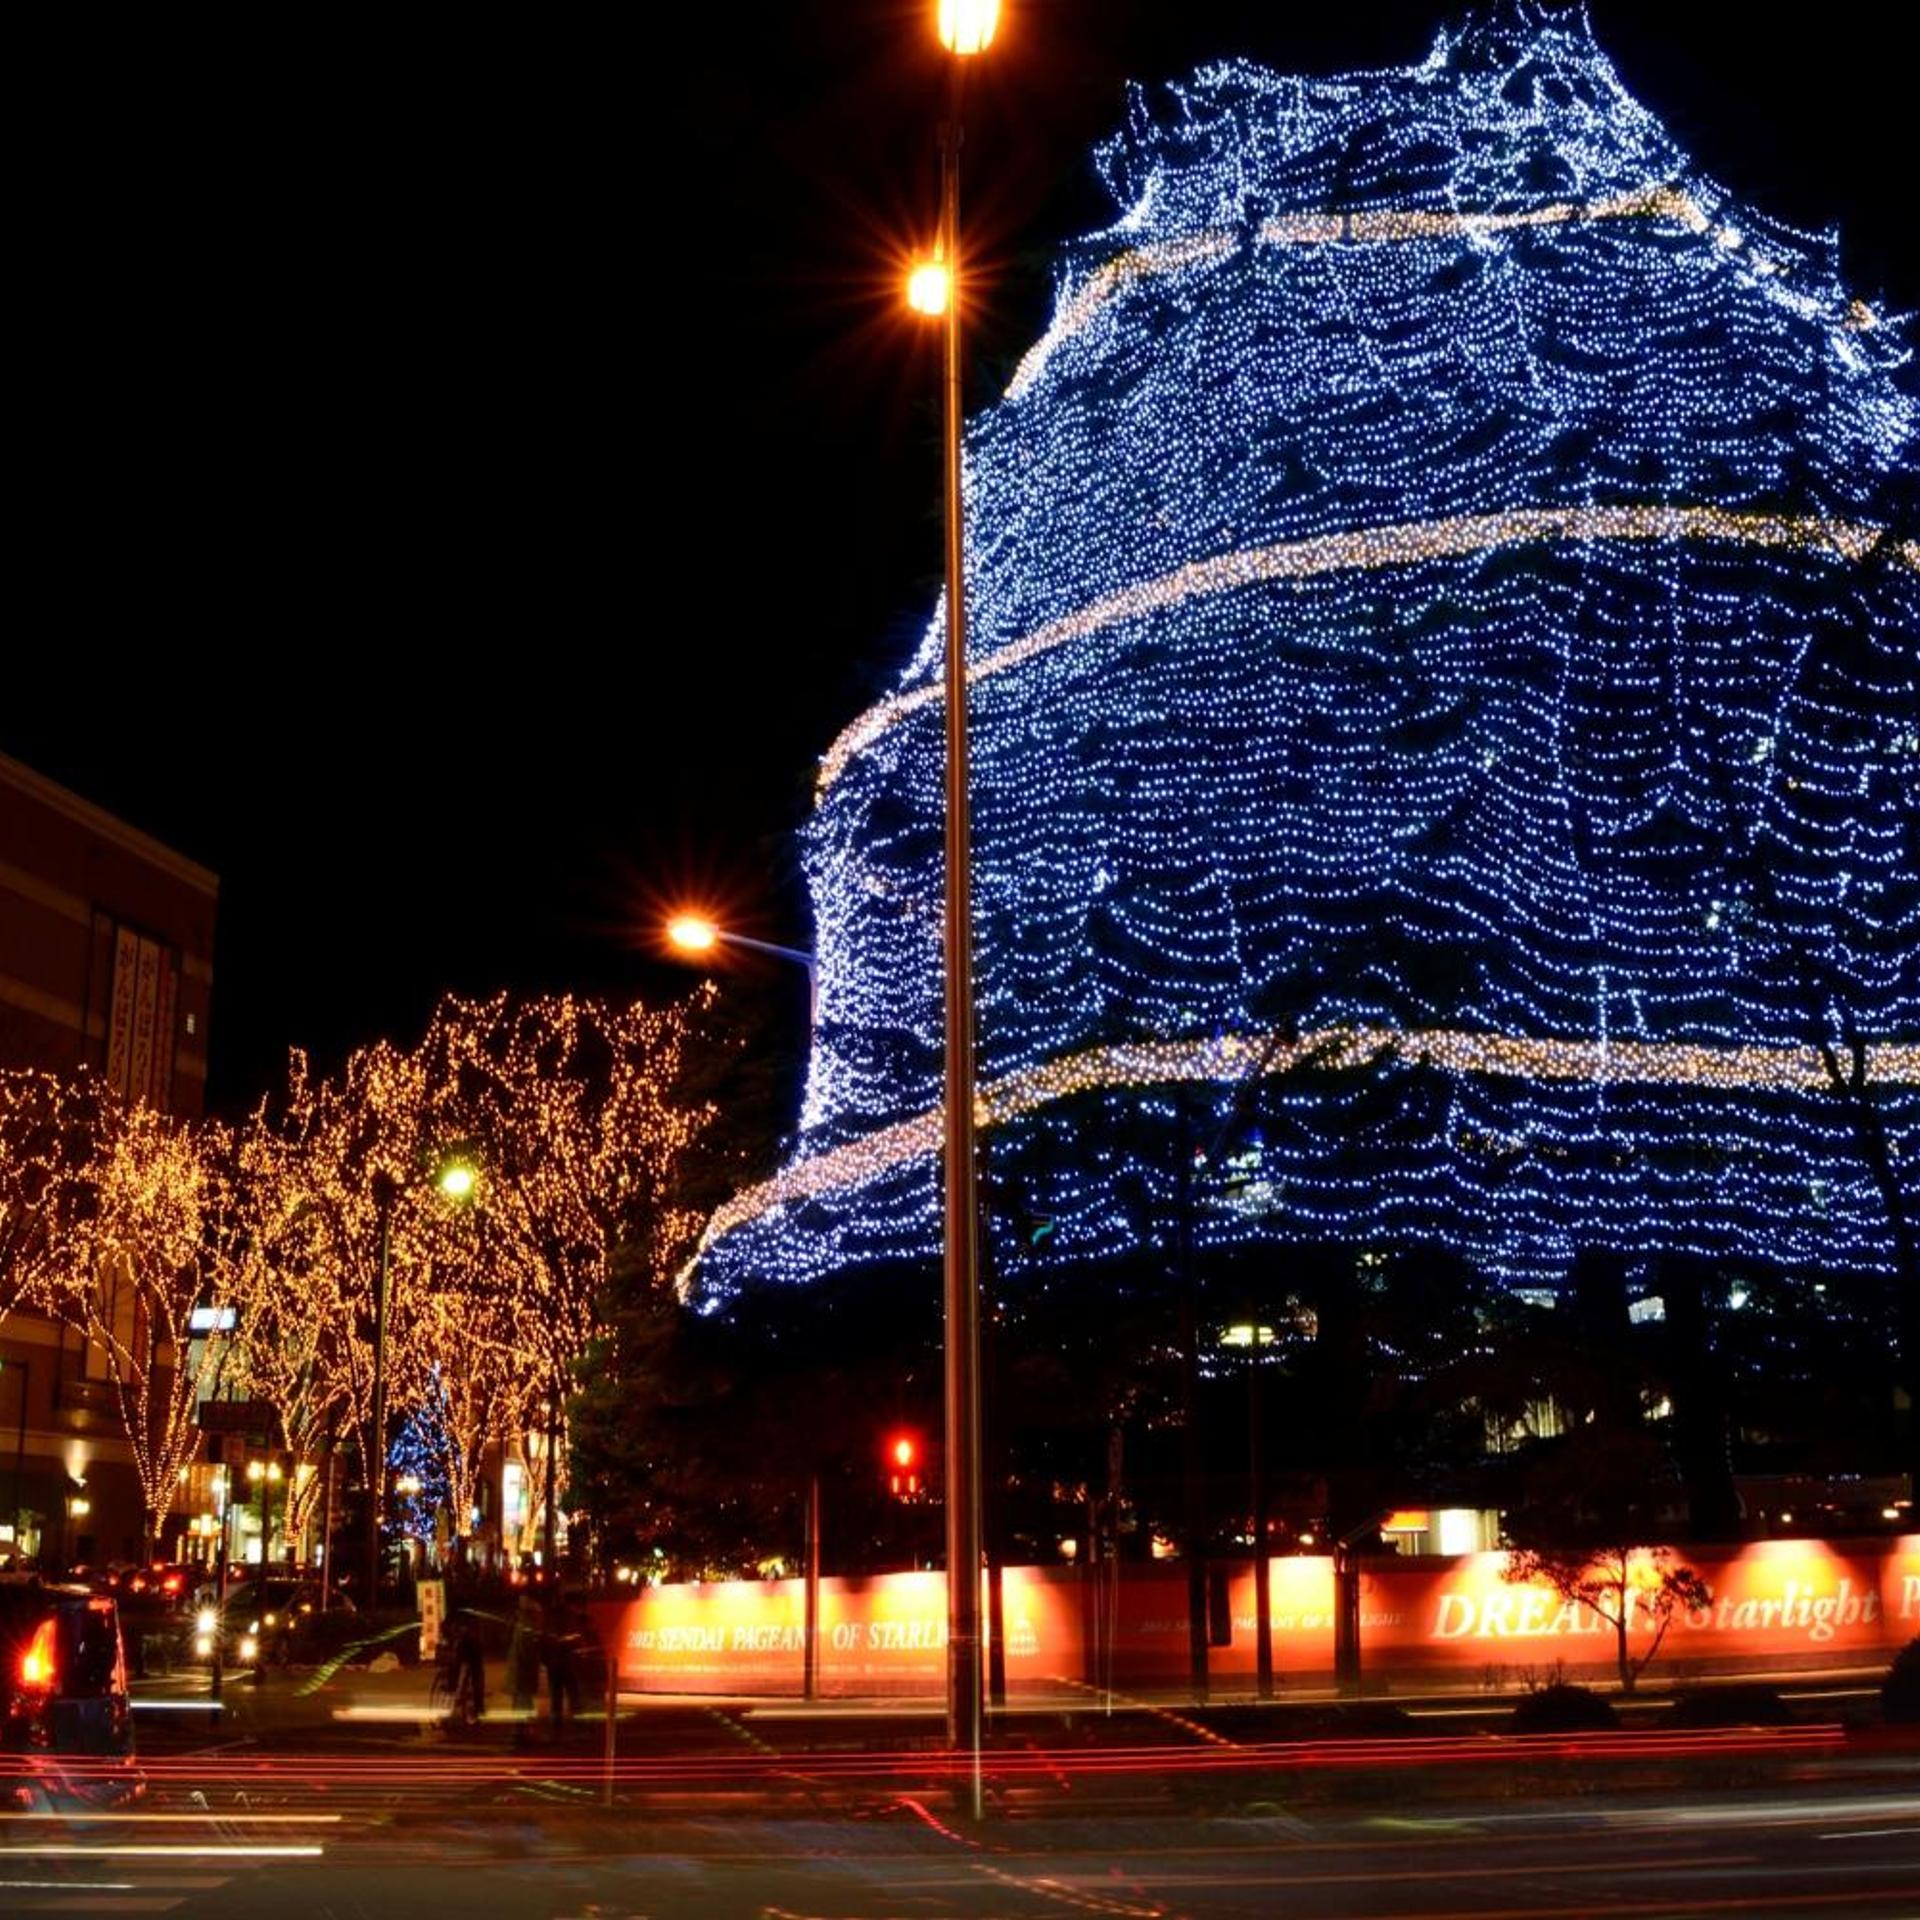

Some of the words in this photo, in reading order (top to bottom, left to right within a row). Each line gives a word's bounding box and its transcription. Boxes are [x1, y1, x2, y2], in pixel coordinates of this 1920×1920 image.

[1684, 1579, 1879, 1642] Starlight
[657, 1626, 725, 1652] SENDAI
[732, 1624, 808, 1651] PAGEAN
[832, 1621, 862, 1650] OF
